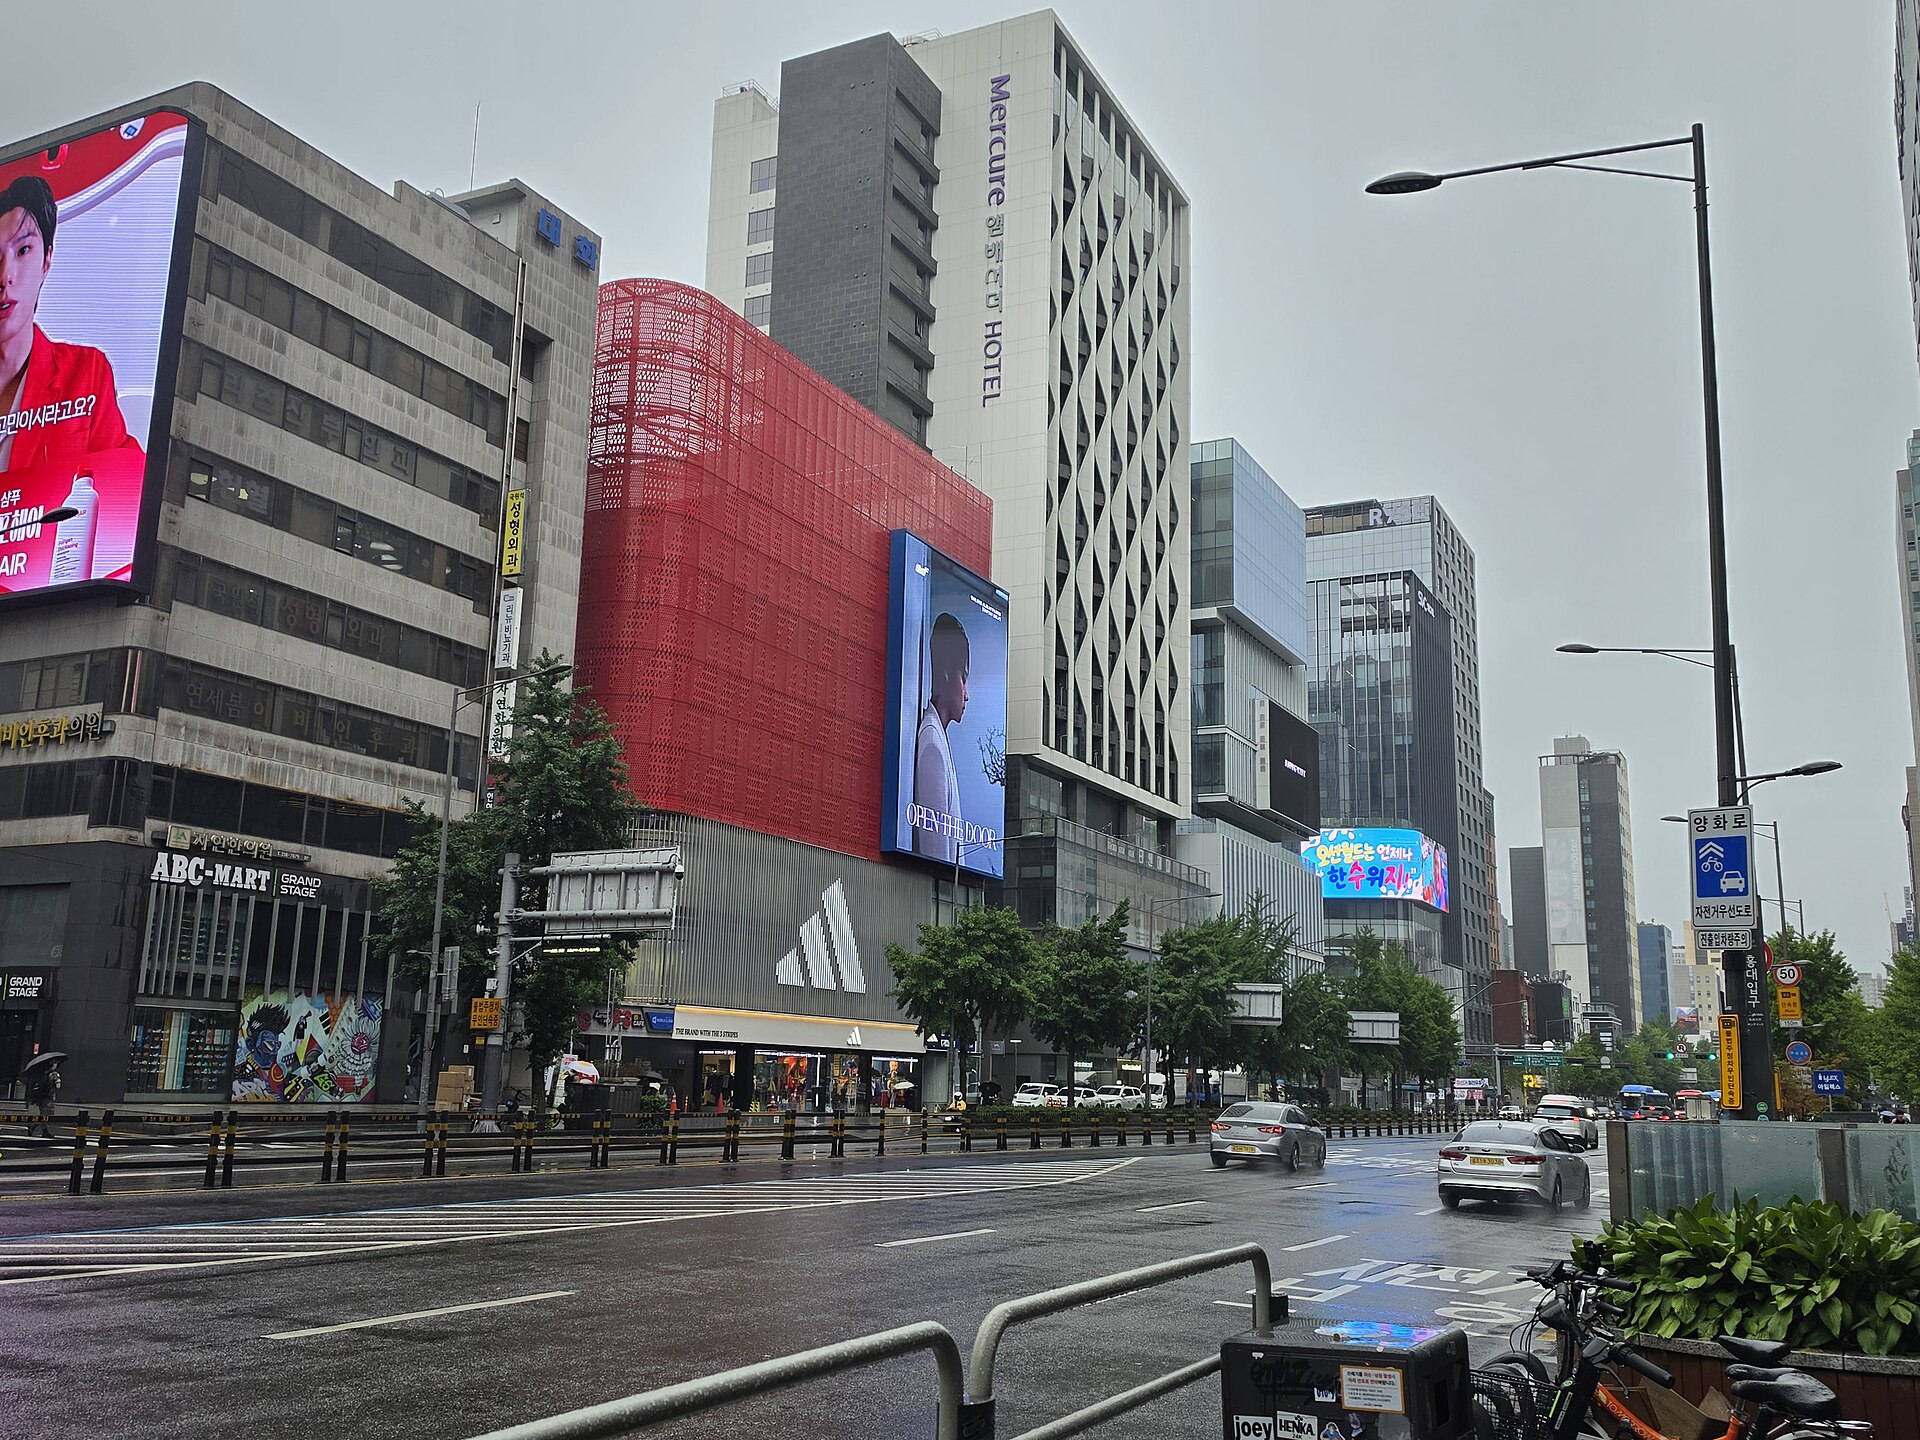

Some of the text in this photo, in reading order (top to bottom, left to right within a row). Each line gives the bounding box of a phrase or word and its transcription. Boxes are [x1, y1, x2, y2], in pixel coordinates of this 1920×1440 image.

[988, 73, 1011, 206] Mercure
[984, 213, 1005, 314] 앰배서더
[983, 320, 1003, 408] HOTEL
[0, 488, 22, 509] 샴푸
[505, 501, 522, 567] 성형외과
[905, 802, 998, 852] OPEN THE DOOR
[1693, 813, 1748, 833] 양화로
[1316, 840, 1413, 868] 오션월드는 언제나
[150, 851, 271, 892] ABC-MART
[280, 873, 322, 888] GRAND
[279, 884, 318, 898] STAGE
[1695, 904, 1753, 919] 자전거우선도로
[1700, 931, 1748, 947] 진출입차량주의
[9, 976, 43, 987] GRAND
[1745, 954, 1761, 1008] 홍대입구
[1779, 968, 1796, 980] 50
[8, 987, 39, 997] STAGE
[472, 1001, 500, 1014] 불법주정차
[472, 1013, 499, 1028] 무인단속중
[684, 1028, 700, 1036] BRAND
[699, 1029, 712, 1037] WITH
[723, 1031, 739, 1039] STRIPES
[1234, 1416, 1273, 1440] joey
[1278, 1418, 1316, 1437] HENKA
